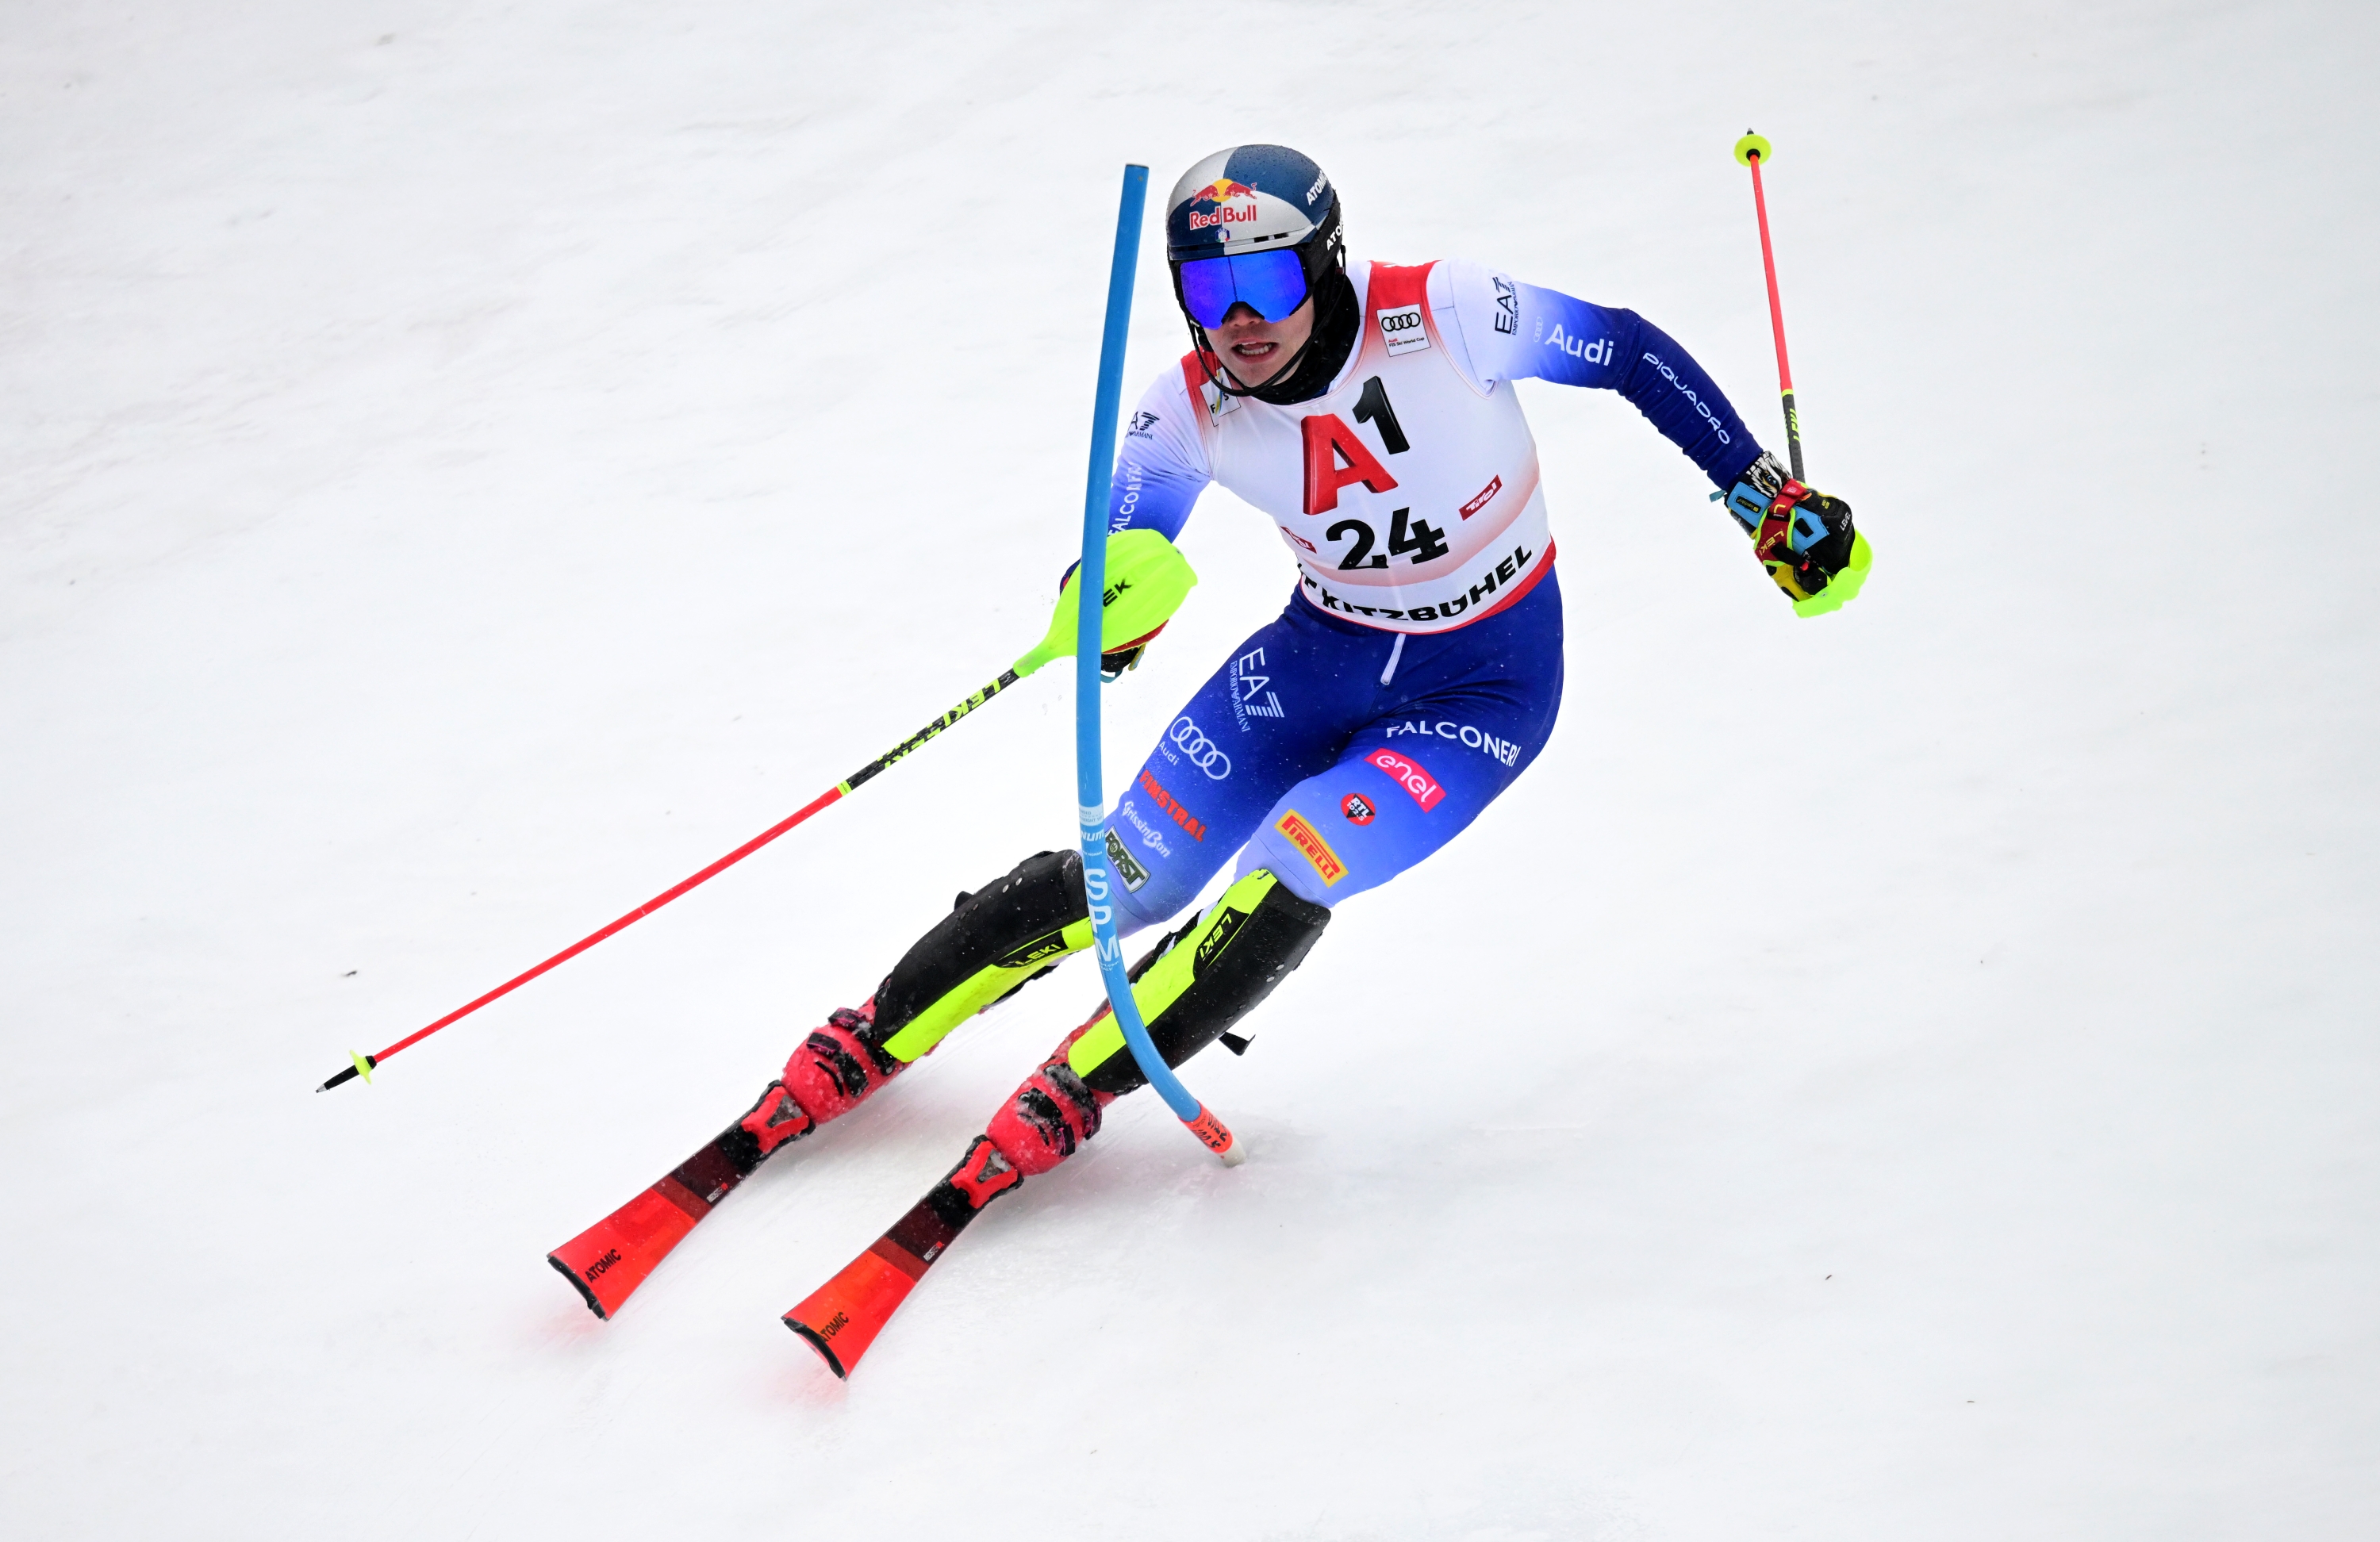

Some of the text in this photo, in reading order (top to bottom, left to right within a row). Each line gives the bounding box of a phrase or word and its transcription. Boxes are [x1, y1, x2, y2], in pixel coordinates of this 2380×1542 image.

[1190, 205, 1256, 229] Red Bull
[1492, 277, 1514, 335] EA7
[1545, 324, 1614, 366] Audi
[1642, 352, 1730, 445] PIQUADRO
[1301, 376, 1410, 516] A1
[1466, 482, 1498, 512] Tirol
[1326, 507, 1449, 570] 24
[1759, 530, 1784, 556] LEKI
[1839, 512, 1852, 531] LEVEL
[942, 678, 1001, 727] LEKI
[1230, 660, 1251, 732] EMPORIO ARMANI
[1238, 647, 1285, 718] EA7
[1159, 741, 1180, 765] Audi
[1386, 721, 1522, 767] FALCONERI
[1376, 754, 1437, 803] enel
[1139, 769, 1207, 842] FINSTRAL
[1346, 801, 1365, 822] 102.5
[1350, 796, 1368, 819] RTL
[1106, 830, 1145, 885] FORST
[1281, 815, 1341, 880] PIRELLI
[1085, 869, 1120, 961] SPM
[1200, 913, 1232, 958] LEKI
[1015, 944, 1061, 965] LEKI
[585, 1249, 621, 1283] ATOMIC
